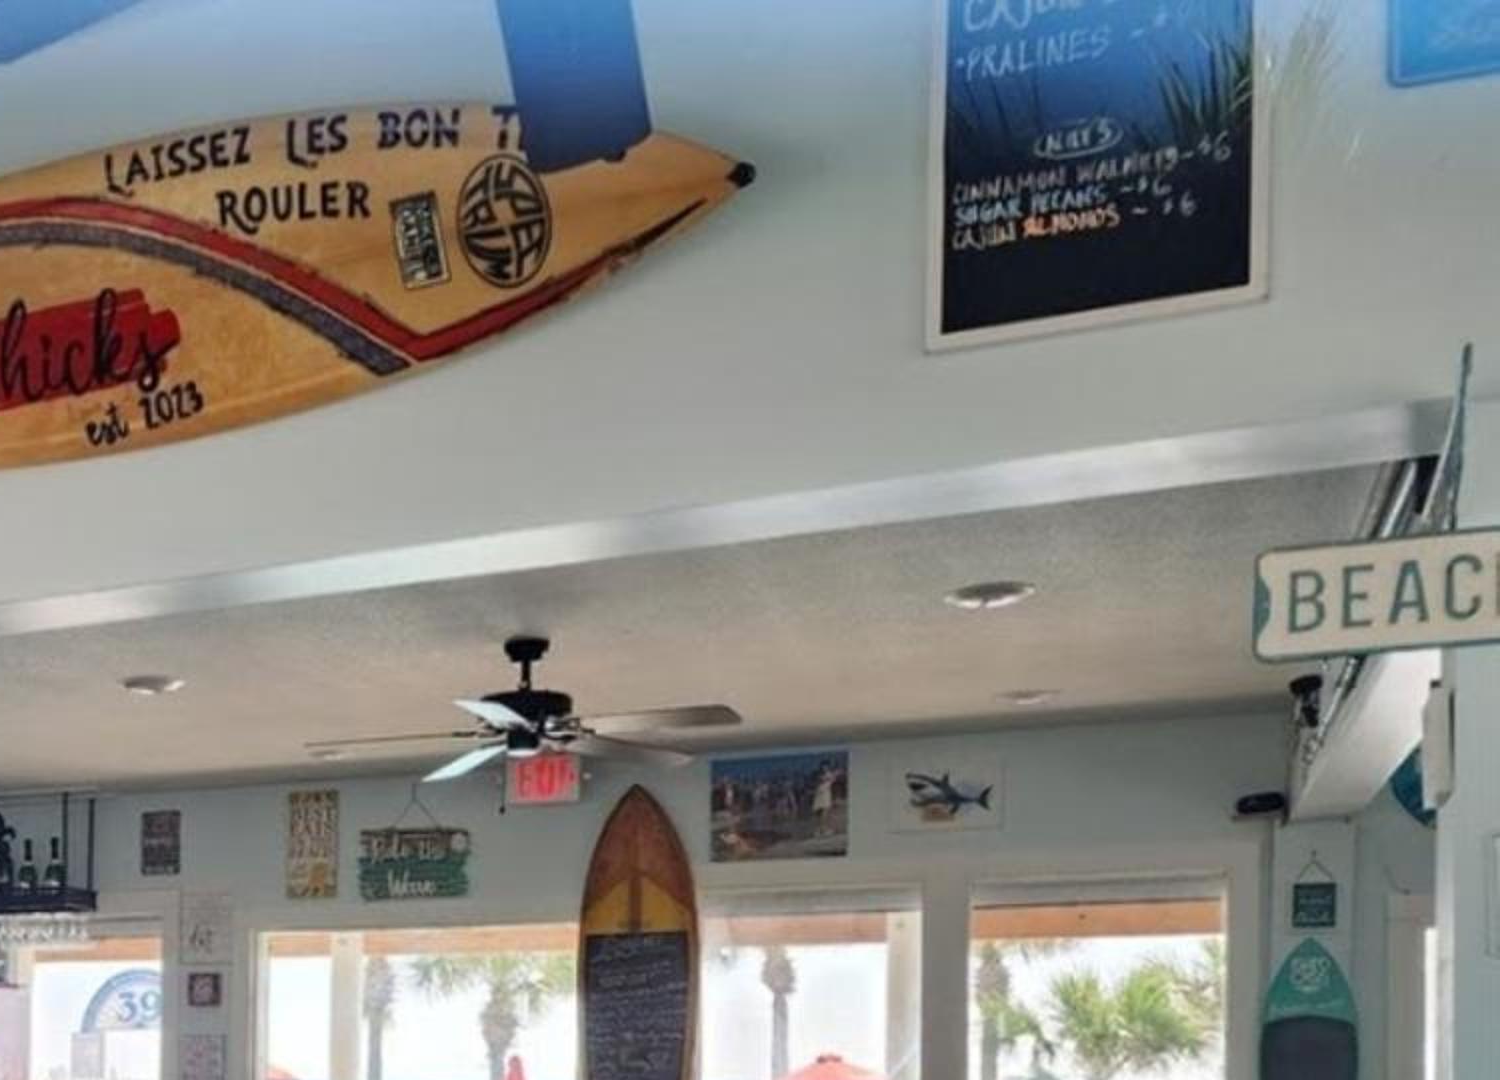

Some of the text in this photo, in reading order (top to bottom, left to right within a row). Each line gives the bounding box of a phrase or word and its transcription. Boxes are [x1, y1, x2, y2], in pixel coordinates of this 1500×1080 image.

[104, 126, 253, 198] LAISSEZ
[286, 114, 349, 169] LES
[377, 108, 462, 149] BON
[215, 180, 372, 234] ROULER
[85, 381, 205, 447] est 2023
[1287, 553, 1500, 634] BEAC
